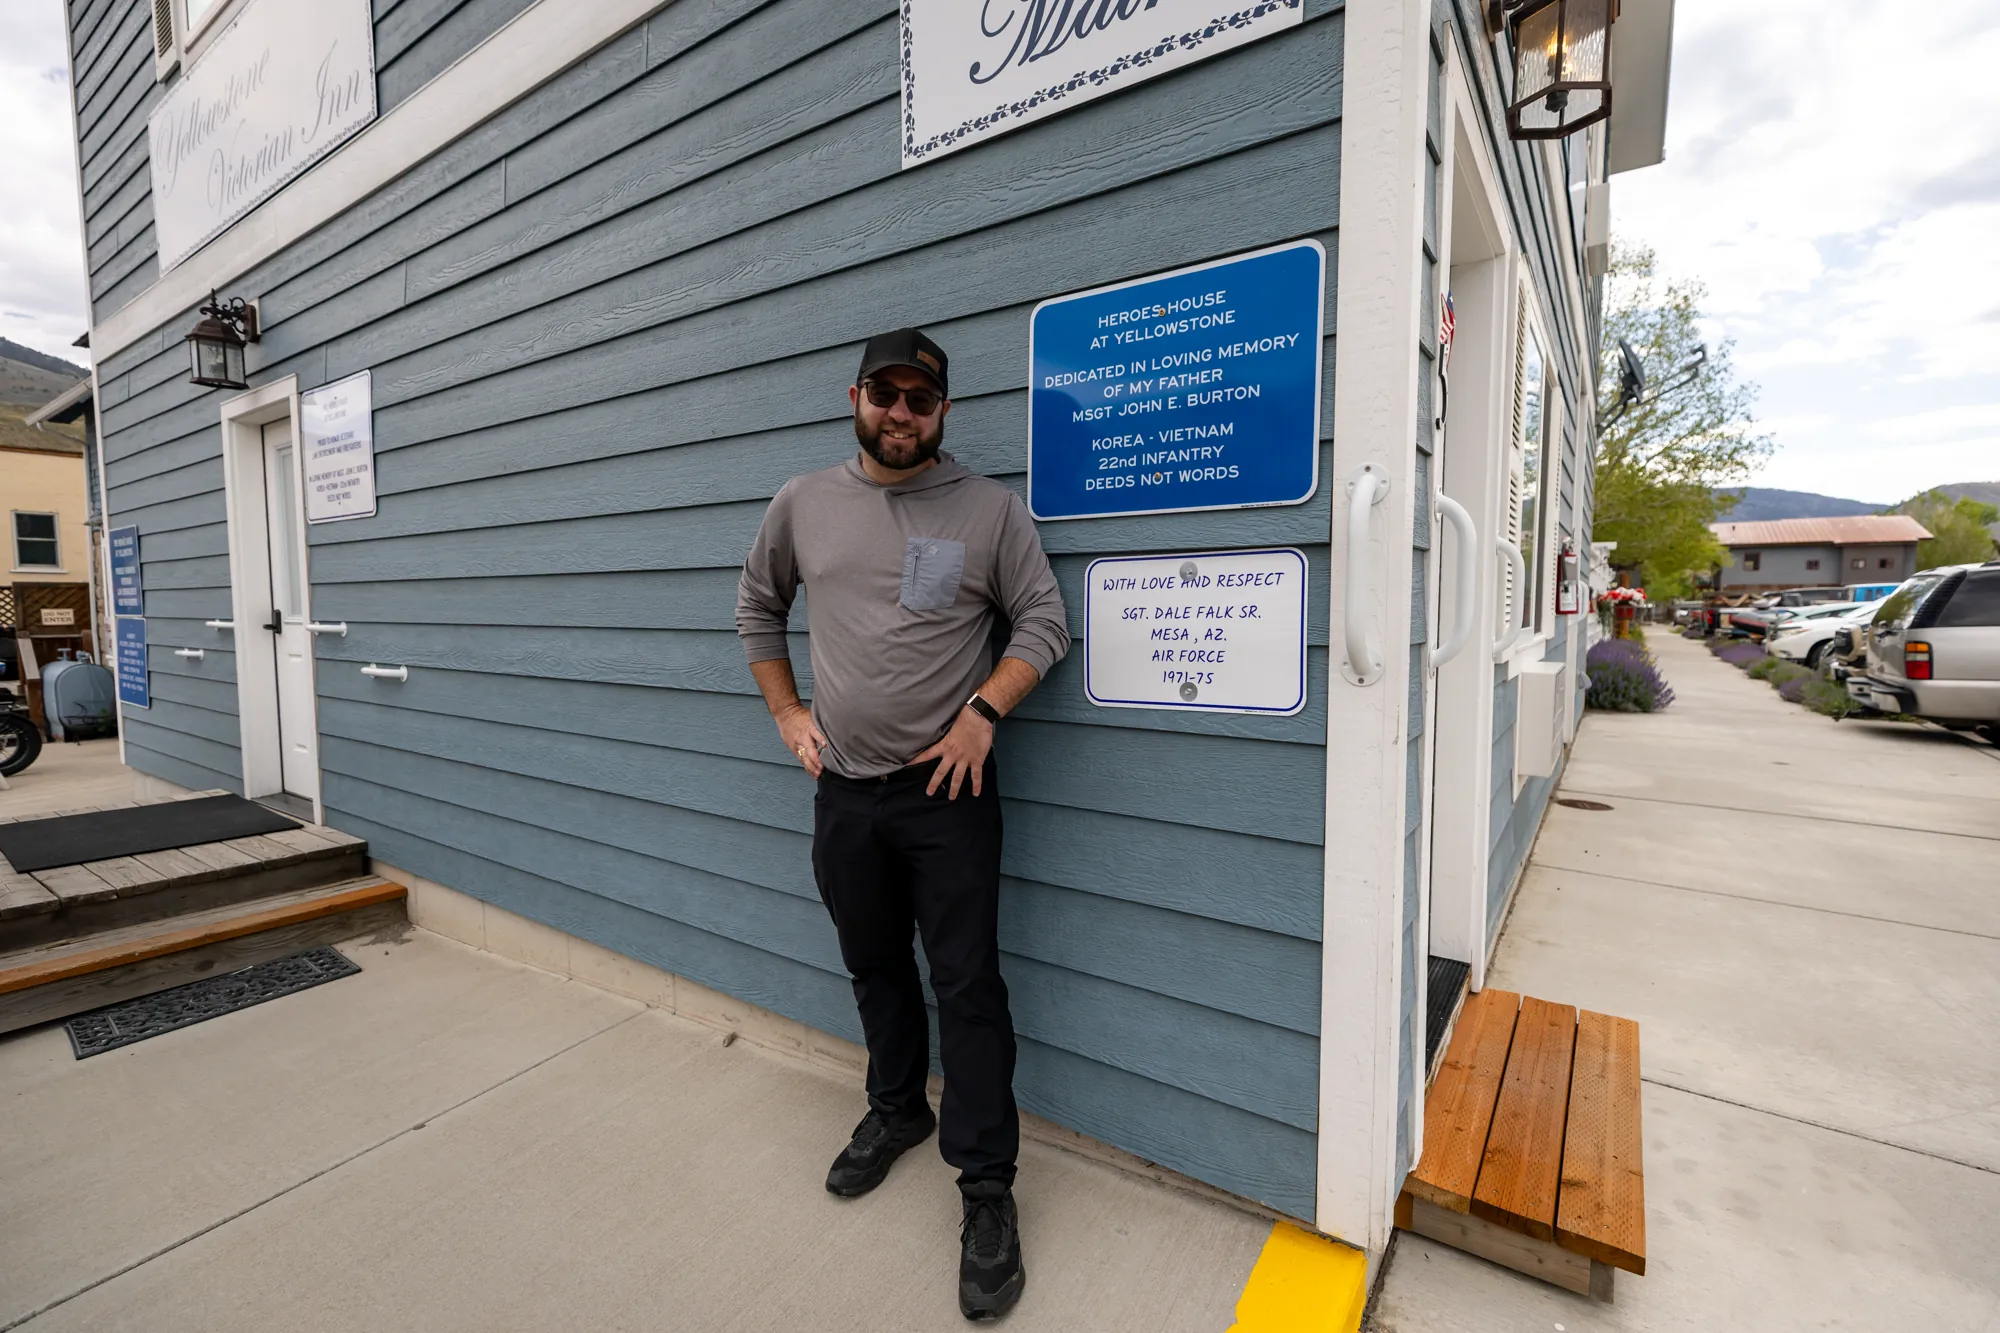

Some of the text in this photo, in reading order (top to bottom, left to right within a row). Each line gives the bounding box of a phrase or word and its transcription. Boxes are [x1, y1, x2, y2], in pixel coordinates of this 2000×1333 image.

[300, 38, 363, 144] Inn
[157, 48, 270, 198] Yellowstone
[1099, 291, 1225, 328] HEROES HOUSE
[1091, 310, 1235, 349] AT YELLOWSTONE
[1045, 333, 1299, 388] DEDICATED IN LOVING MEMORY
[1104, 369, 1222, 398] OF MY FATHER
[1074, 385, 1259, 421] MSGT JOHN E. BURTON
[1093, 434, 1144, 450] KOREA
[1159, 423, 1232, 442] VIETNAM
[1099, 446, 1223, 469] 22nd INFANTRY
[1086, 466, 1238, 490] DEEDS NOT WORDS
[1104, 572, 1284, 590] WITH LOVE AND RESPECT
[1123, 605, 1261, 620] SGT. DALE FALK SR.
[1204, 628, 1227, 640] AZ.
[1152, 649, 1224, 662] AIR FORCE
[1164, 671, 1213, 684] 1971-75
